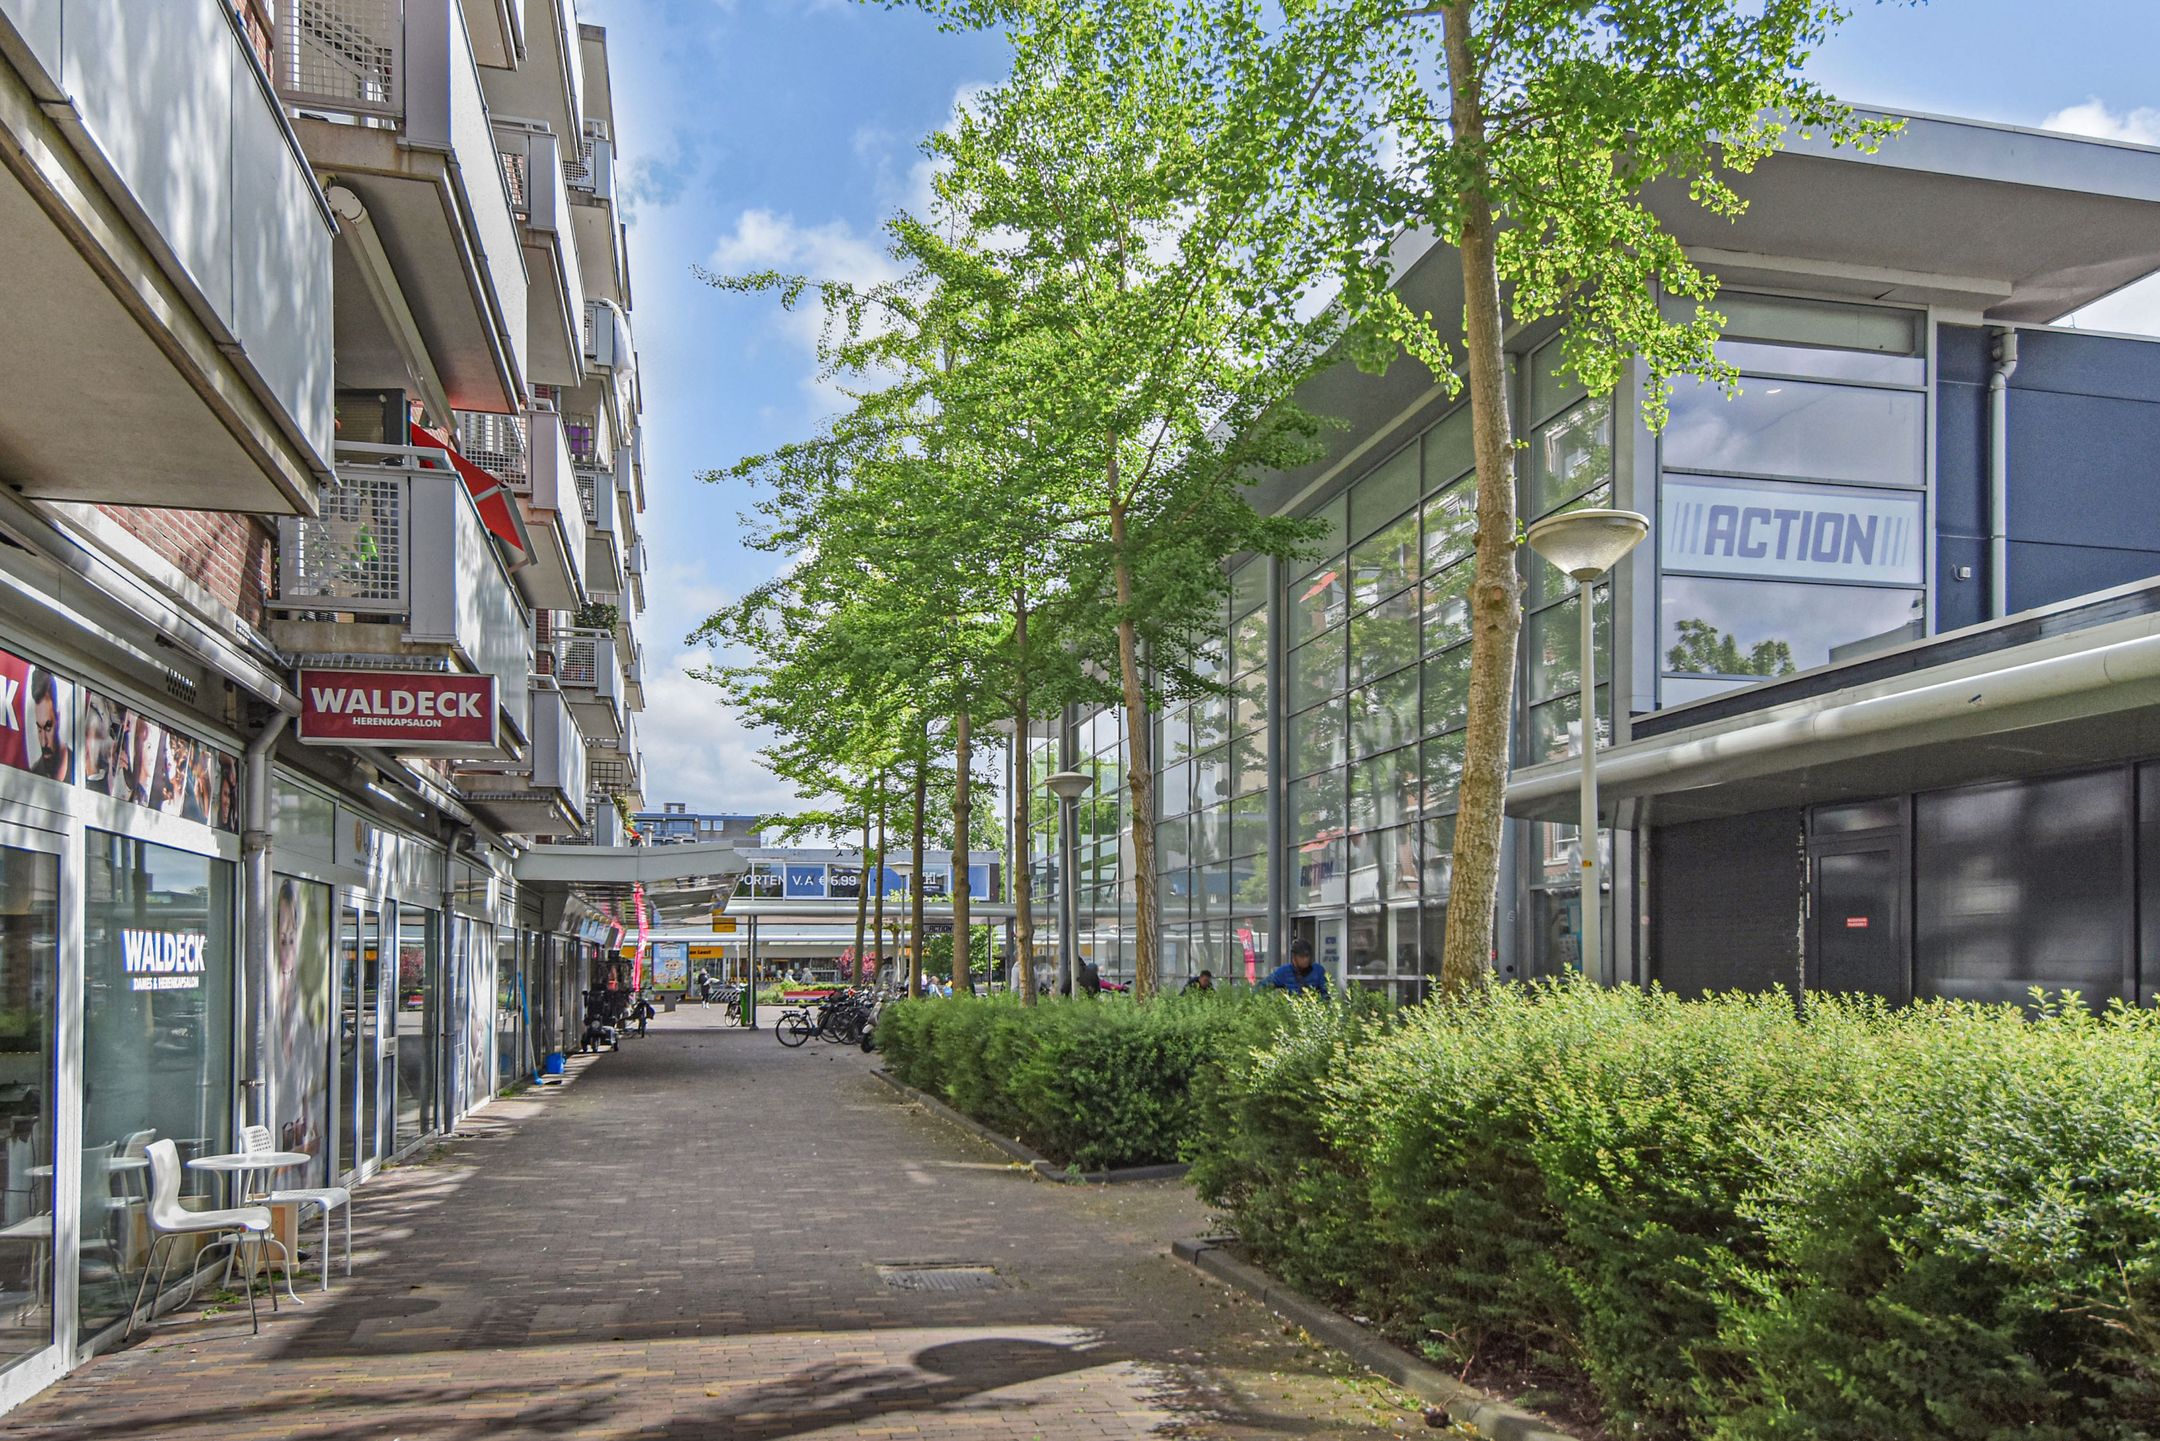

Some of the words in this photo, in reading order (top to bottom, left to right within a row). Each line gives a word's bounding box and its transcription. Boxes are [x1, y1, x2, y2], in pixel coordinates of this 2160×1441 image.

[1704, 504, 1878, 566] ACTION
[310, 687, 482, 718] WALDECK
[352, 716, 442, 728] HERENKAPSALON
[928, 925, 953, 934] ACTION
[121, 929, 206, 973] WALDECK
